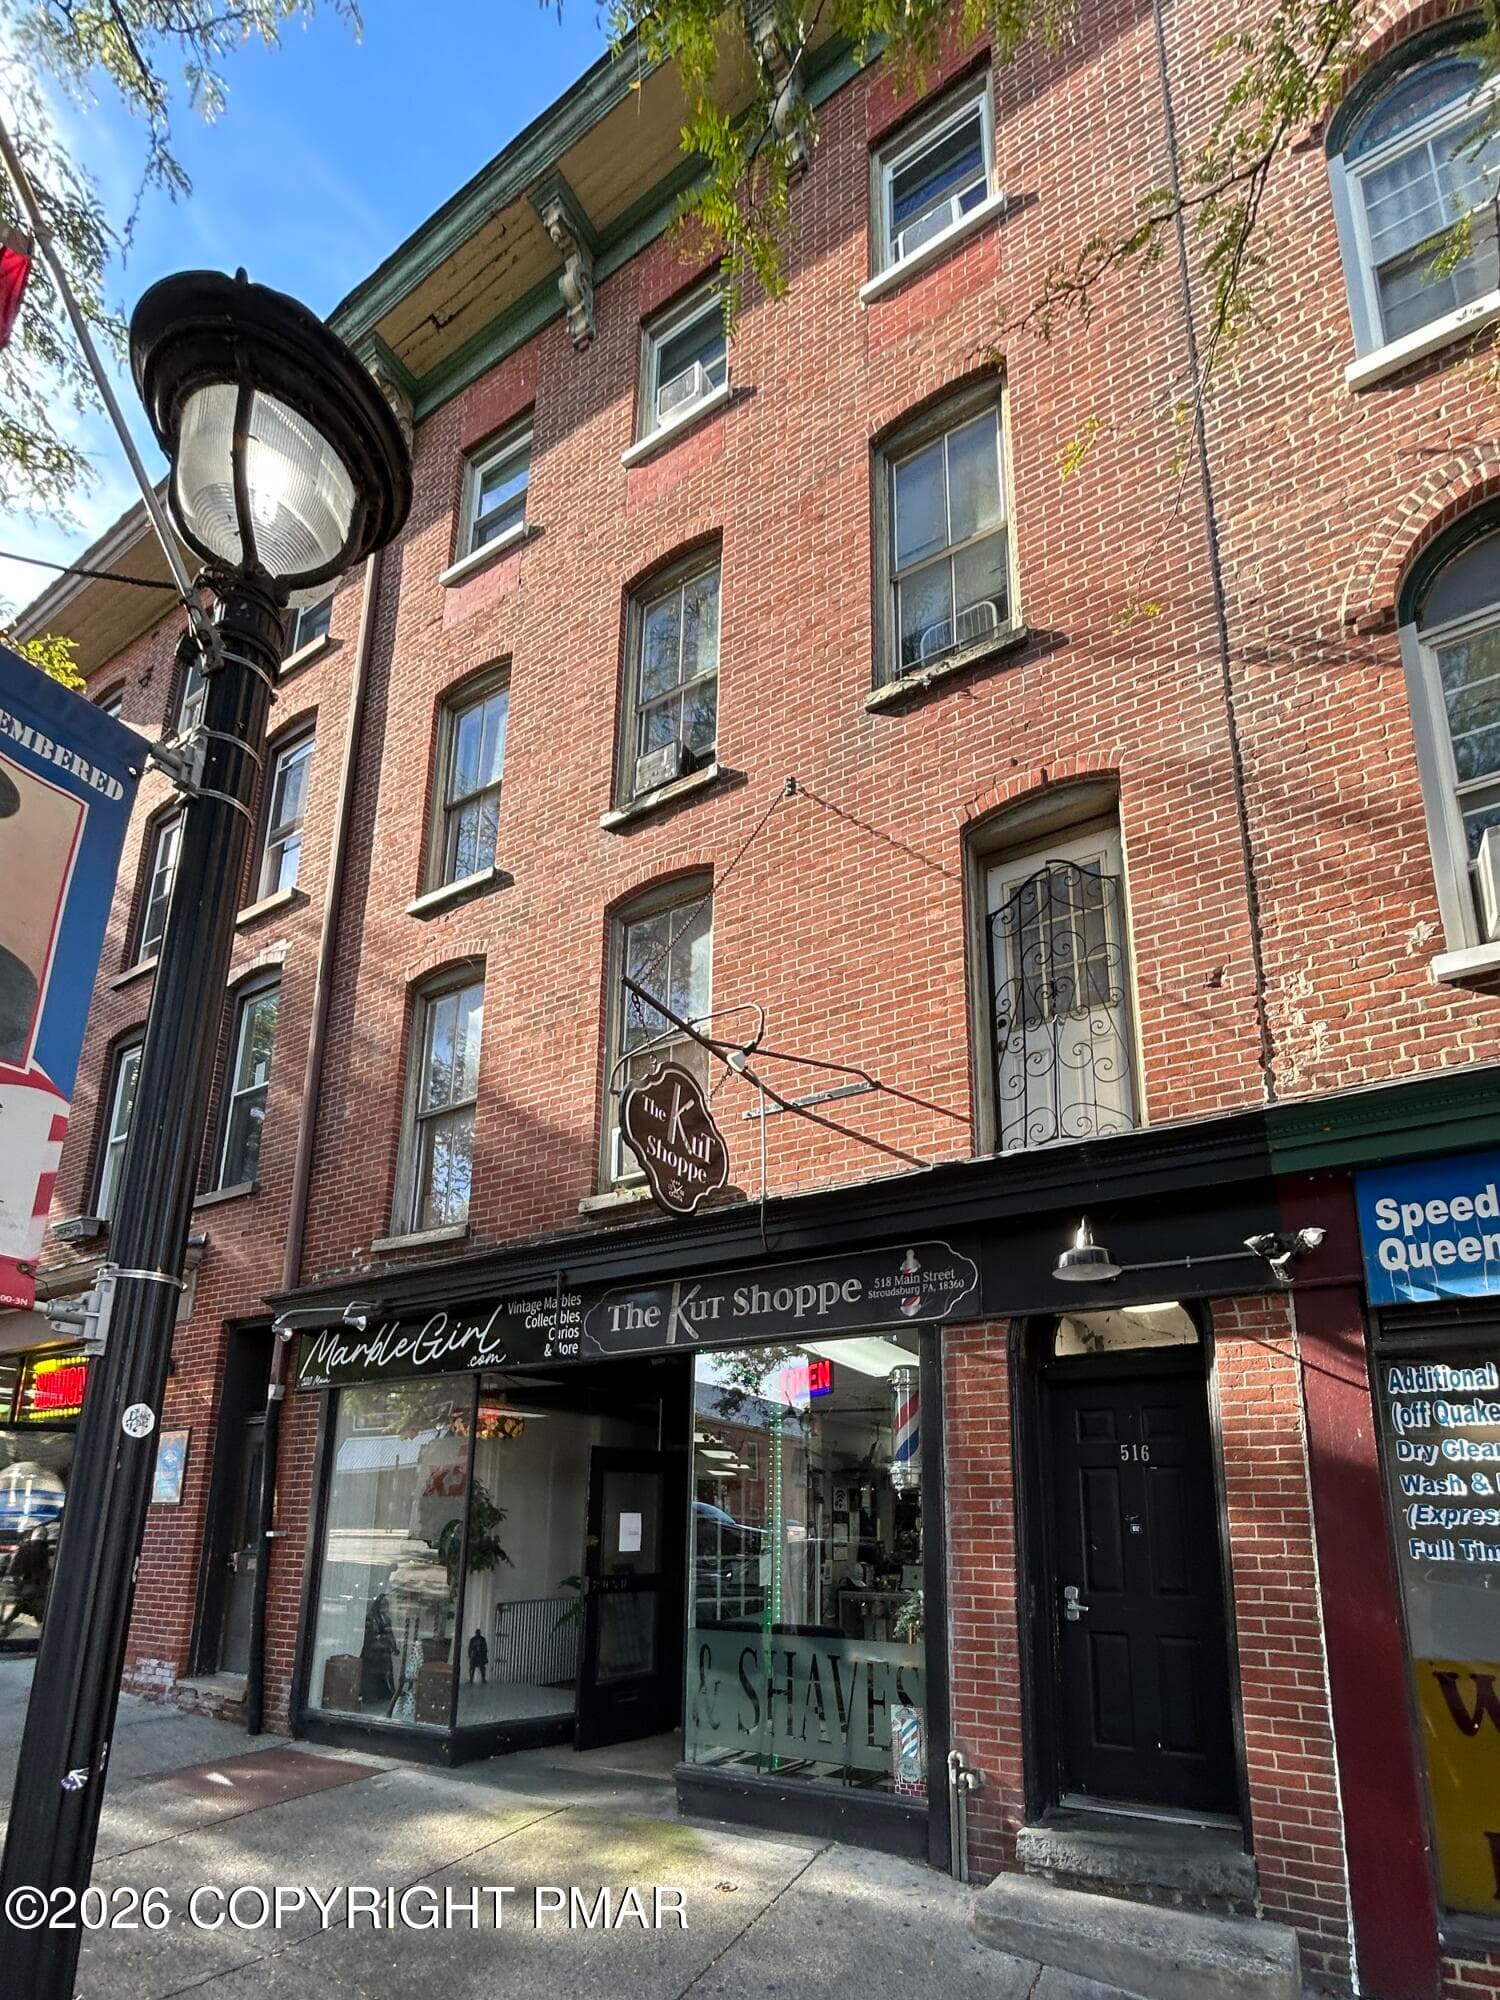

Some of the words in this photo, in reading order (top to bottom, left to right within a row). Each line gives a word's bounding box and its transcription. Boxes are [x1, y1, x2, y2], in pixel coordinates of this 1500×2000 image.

[642, 1094, 666, 1122] The
[647, 1135, 707, 1183] Shoppe
[1376, 1184, 1500, 1236] Speed
[1378, 1235, 1500, 1272] Queen
[868, 1286, 920, 1299] Stroudsburg
[939, 1279, 965, 1290] 18360
[874, 1277, 892, 1288] 518
[894, 1274, 920, 1285] Main
[923, 1269, 955, 1282] Street
[508, 1300, 542, 1315] Vintage
[544, 1293, 582, 1310] Mables
[608, 1302, 660, 1332] The
[732, 1277, 862, 1320] Shoppe
[544, 1343, 552, 1357] &
[780, 1360, 830, 1399] OPEN
[1388, 1362, 1498, 1394] Additional
[1392, 1401, 1431, 1435] (off
[1120, 1444, 1150, 1462] 516
[1396, 1440, 1439, 1466] Dry
[1400, 1473, 1467, 1496] Wash
[1471, 1472, 1494, 1495] &
[1409, 1539, 1455, 1561] Full
